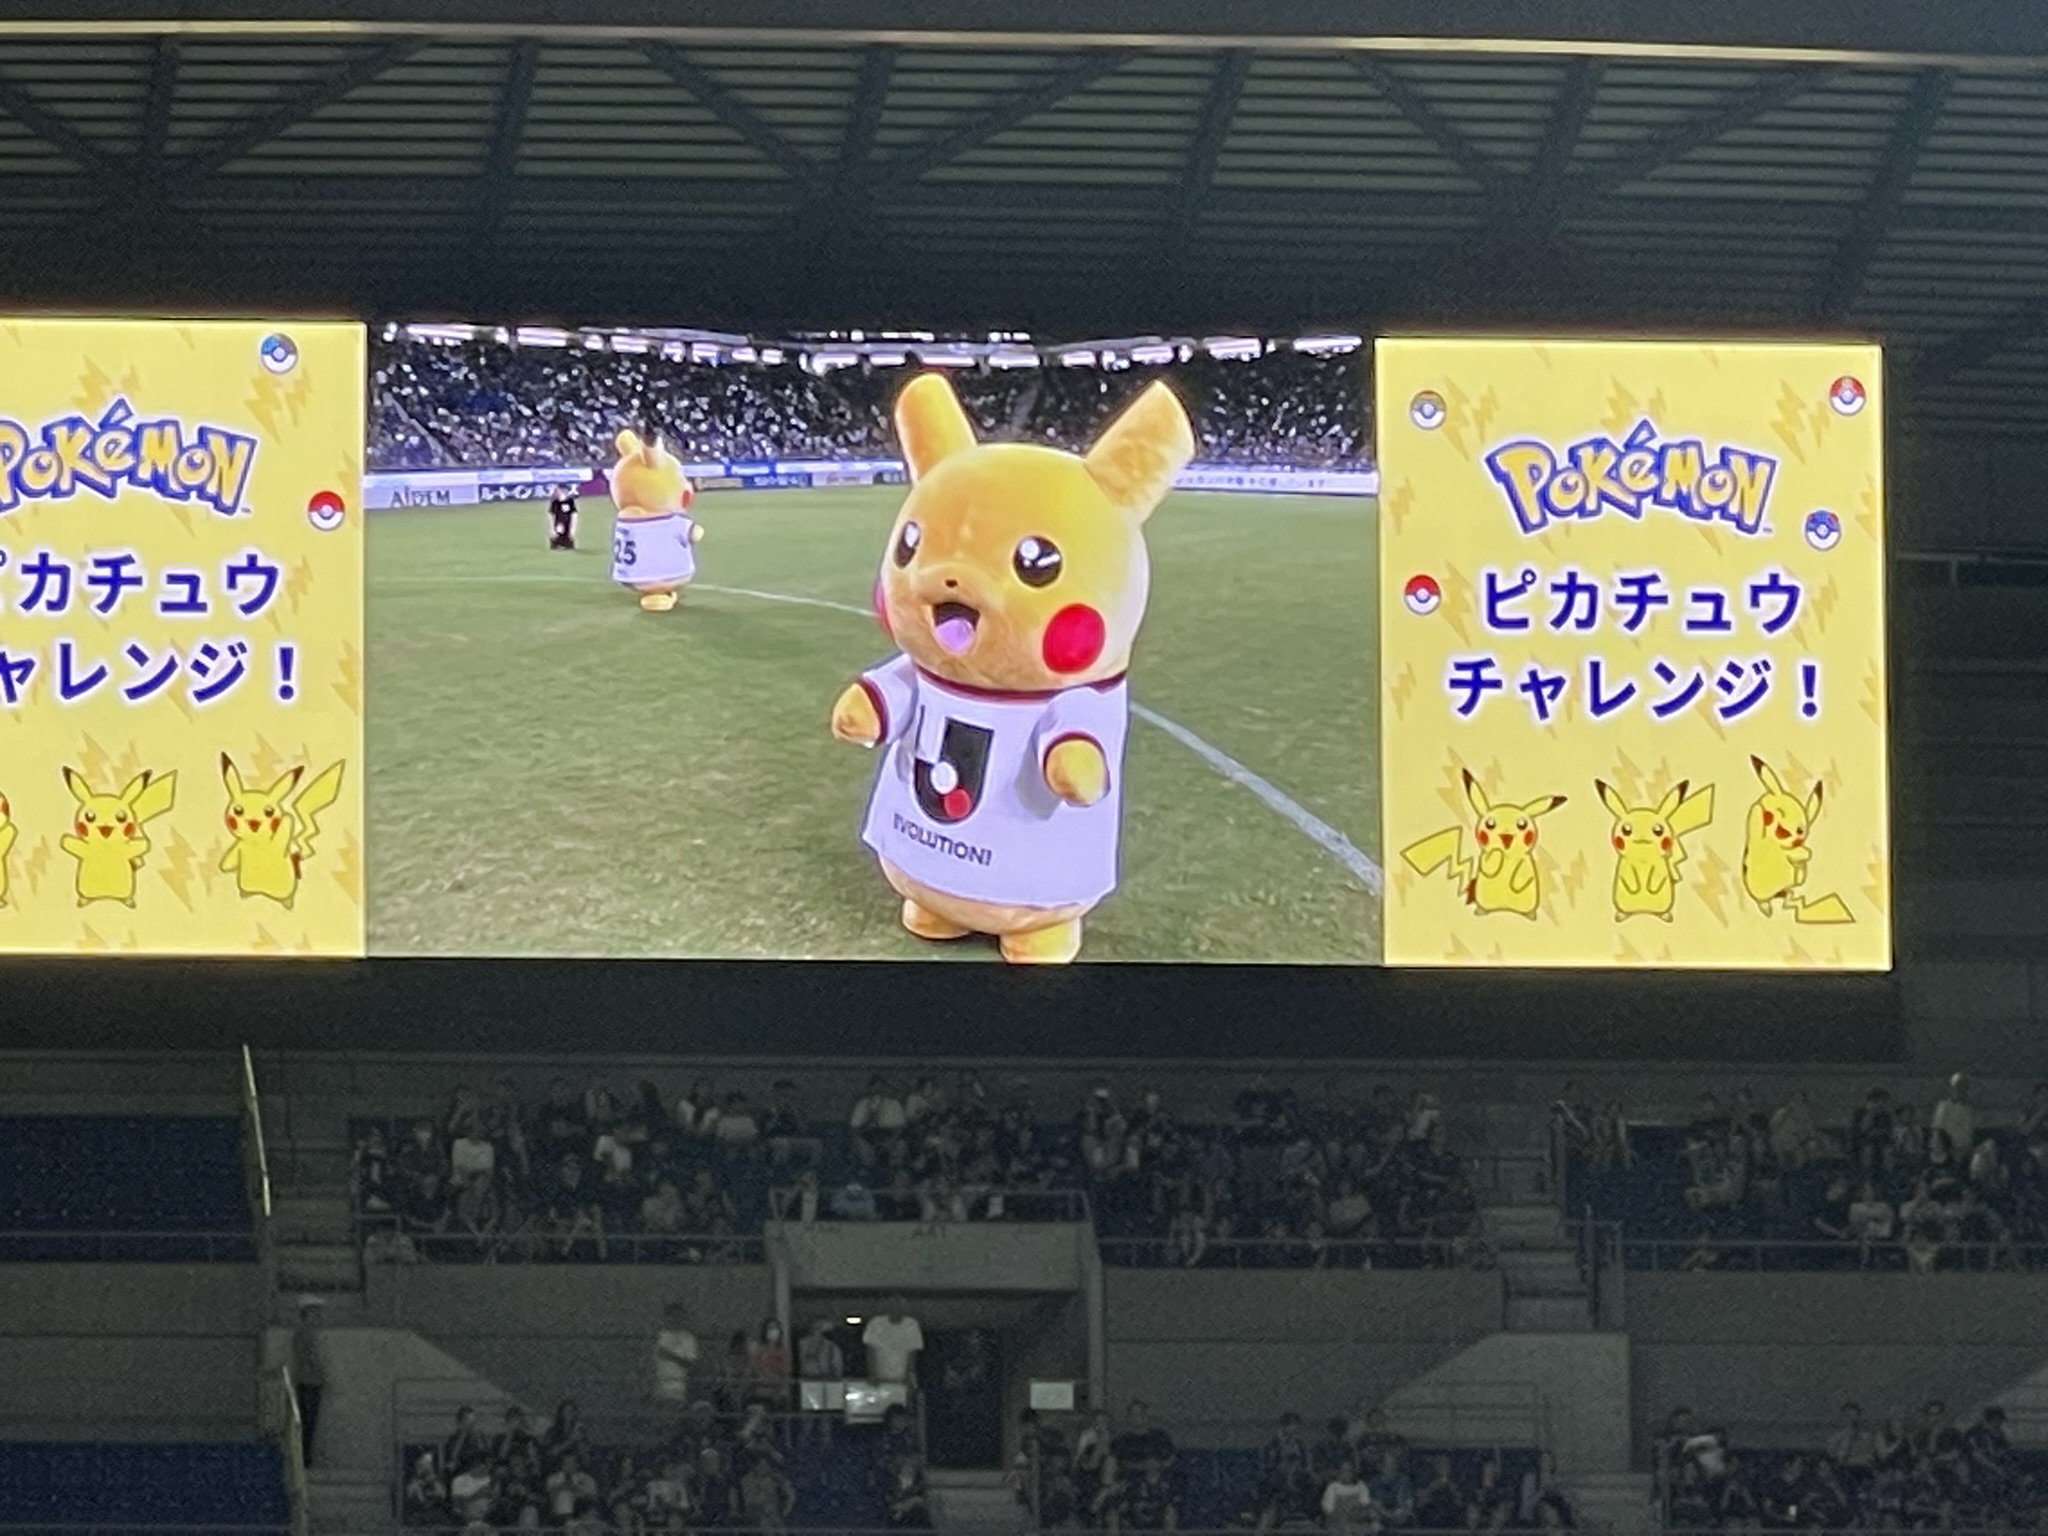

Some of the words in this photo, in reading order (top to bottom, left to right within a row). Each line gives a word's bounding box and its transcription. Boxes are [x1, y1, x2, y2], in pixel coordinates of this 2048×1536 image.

[0, 550, 279, 616] カチュウ
[1486, 568, 1800, 634] ピカチュウ
[1448, 657, 1818, 721] チャレンジ！
